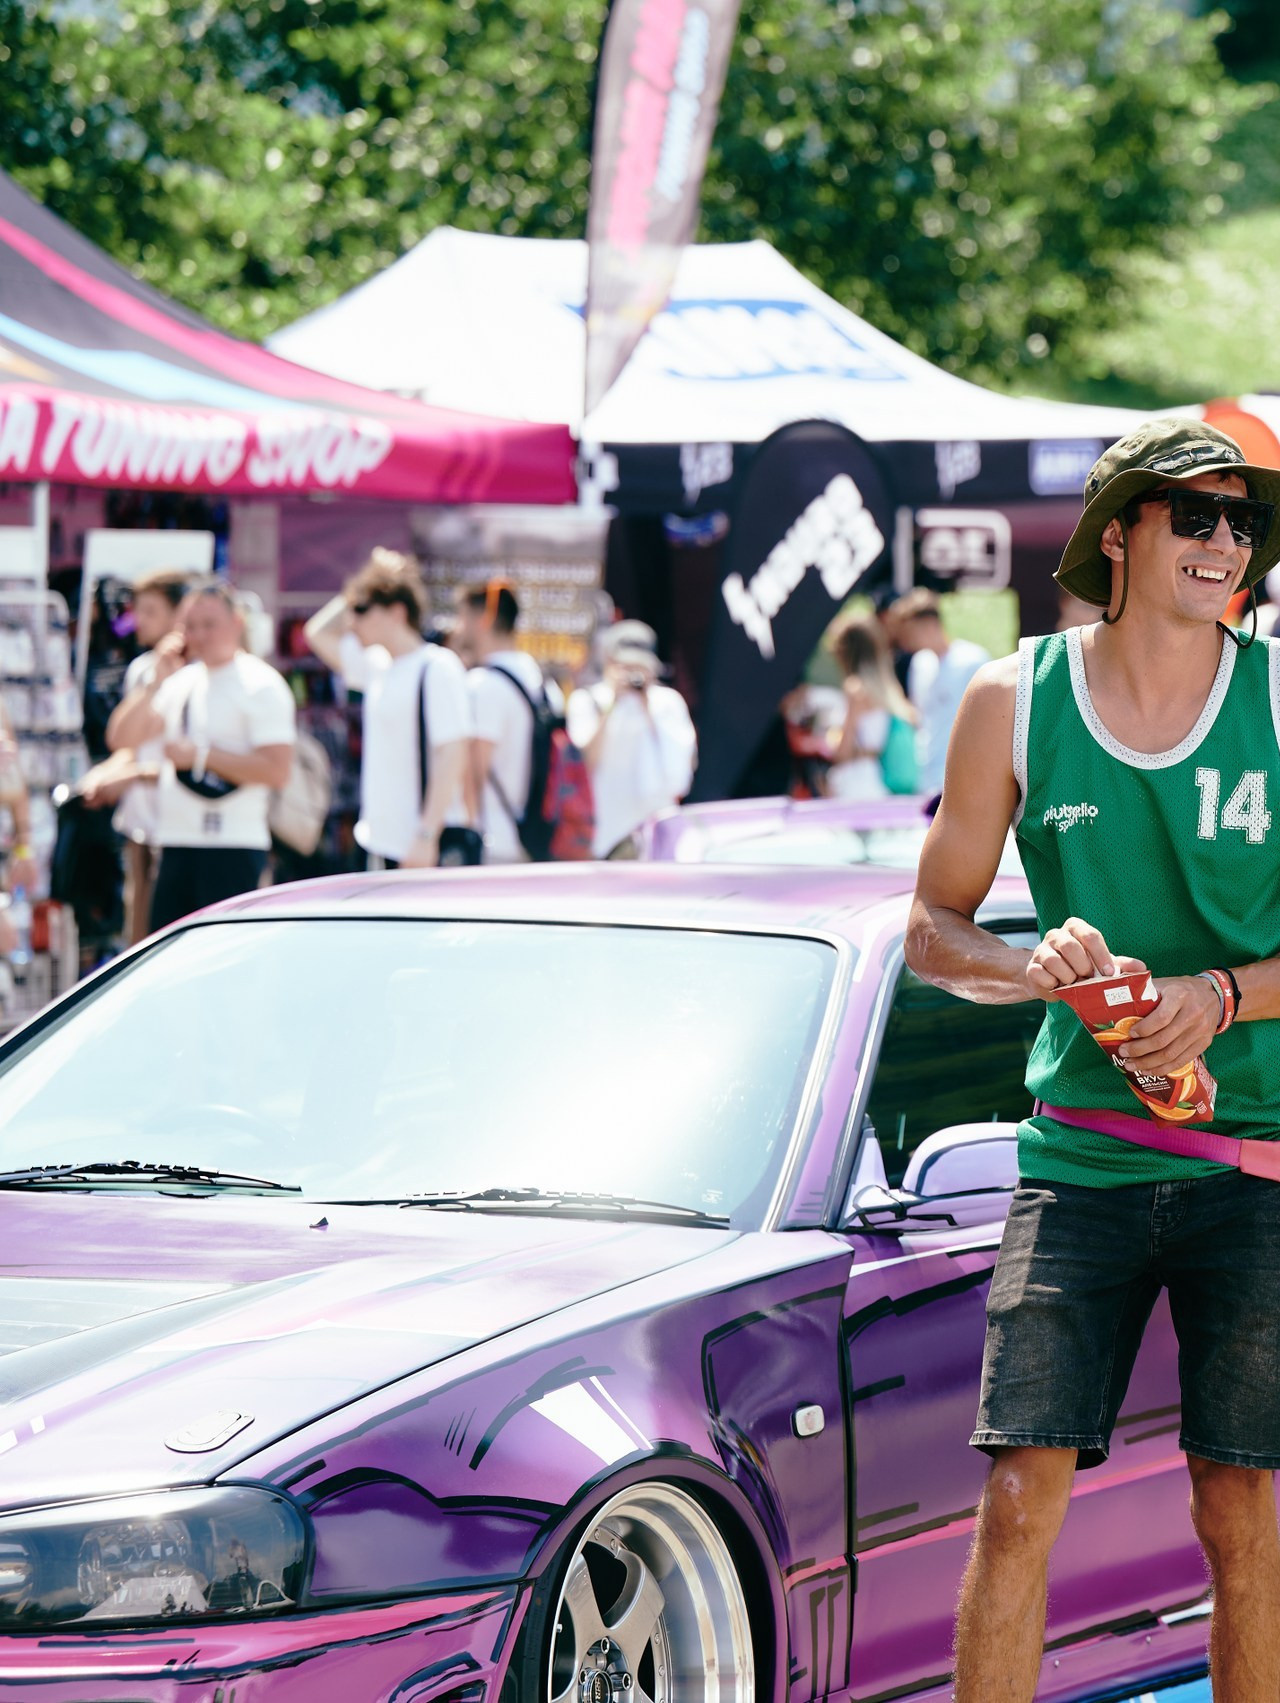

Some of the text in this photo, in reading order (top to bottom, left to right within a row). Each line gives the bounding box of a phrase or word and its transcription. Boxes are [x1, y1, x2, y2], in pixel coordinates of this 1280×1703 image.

[41, 396, 247, 486] TUNING
[246, 412, 394, 488] SHOP
[1195, 766, 1272, 844] 14
